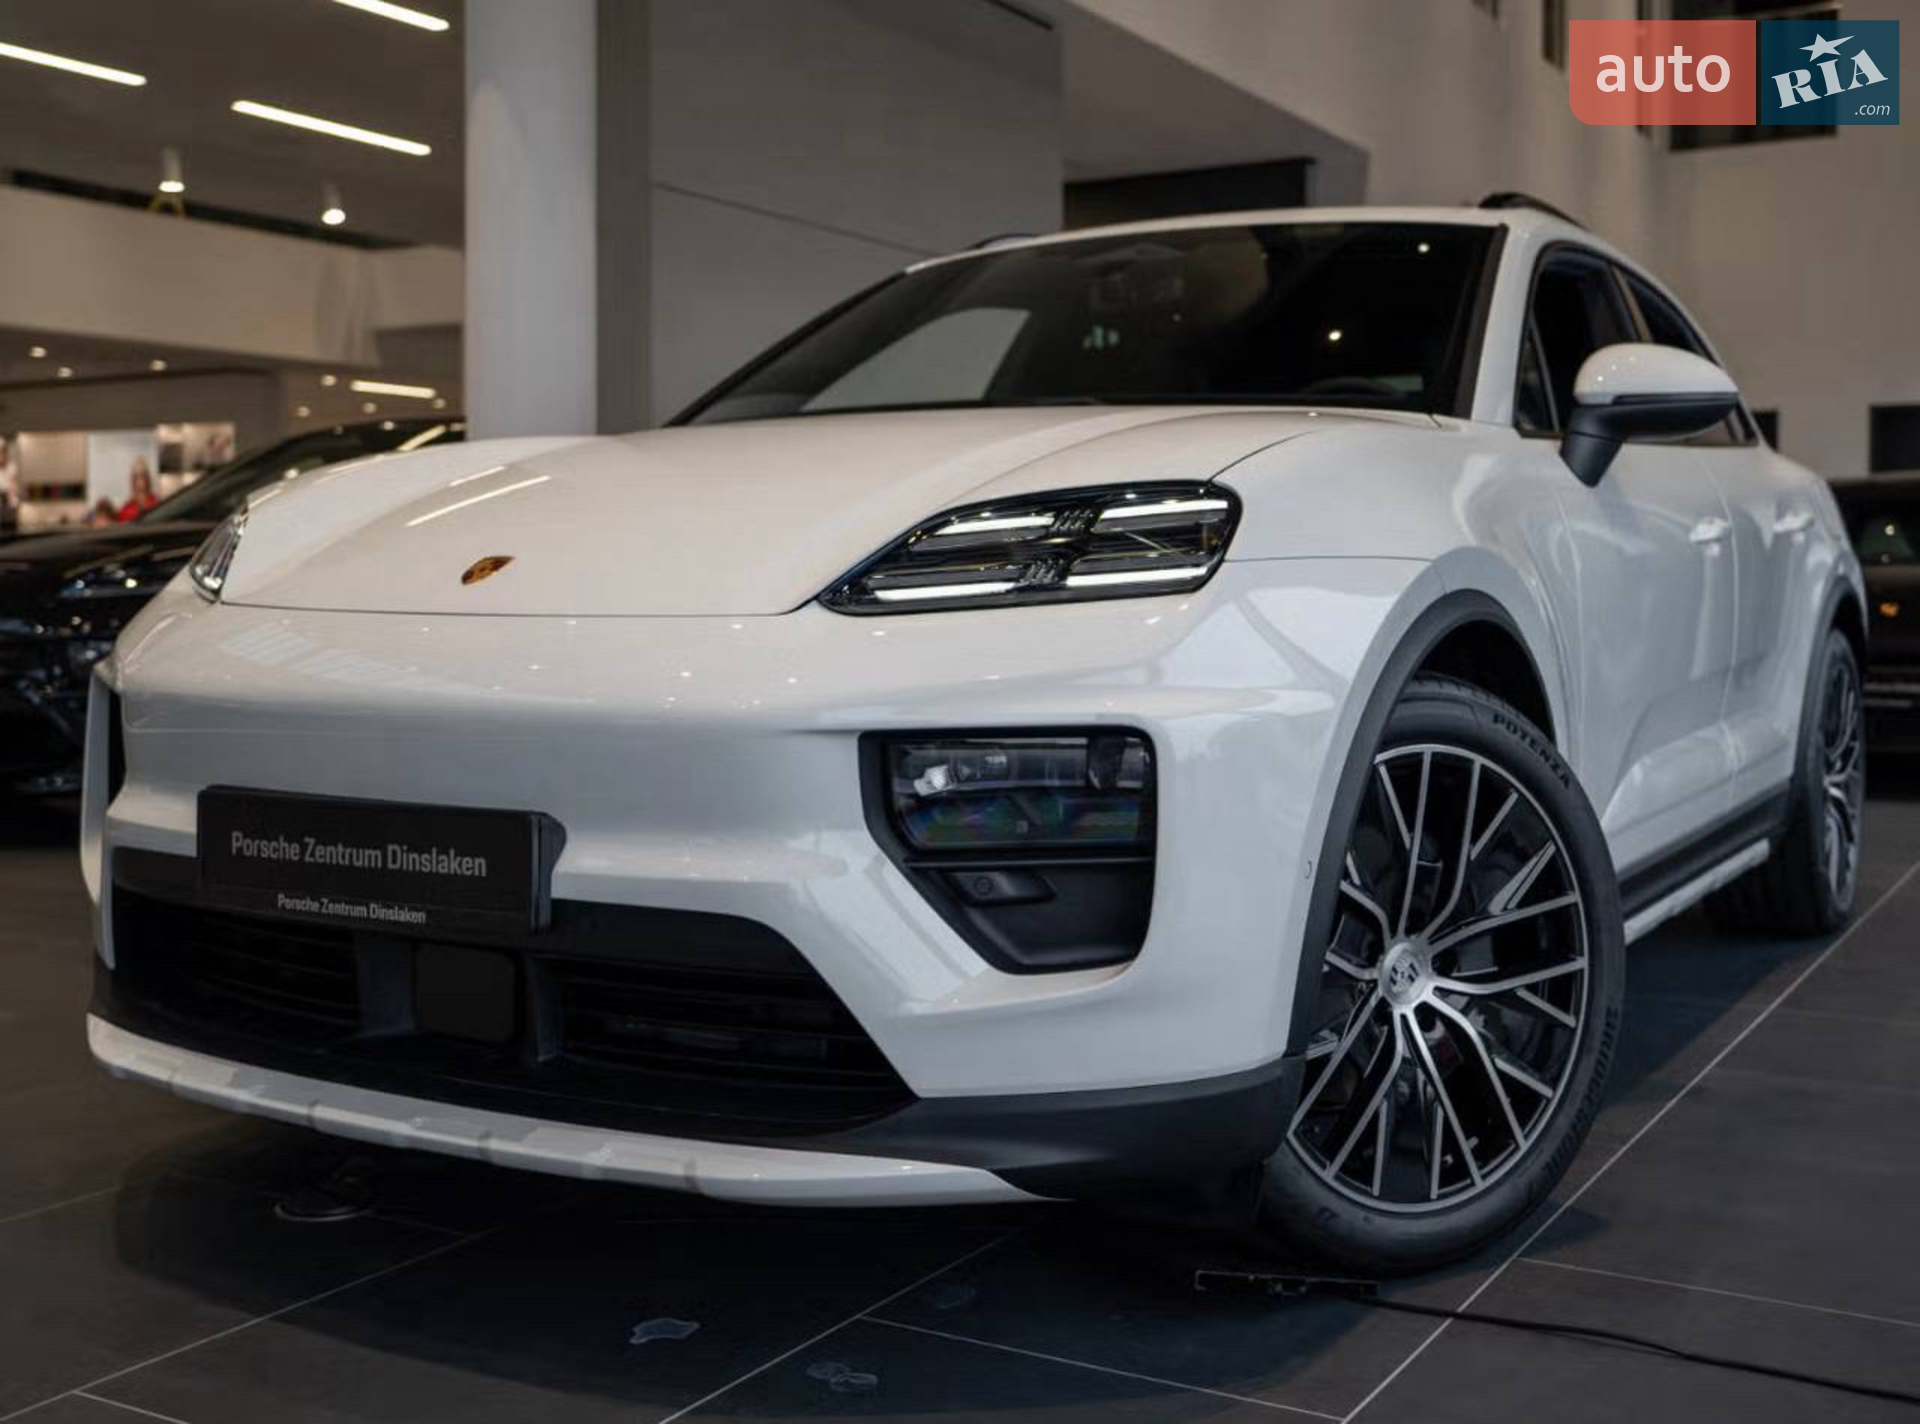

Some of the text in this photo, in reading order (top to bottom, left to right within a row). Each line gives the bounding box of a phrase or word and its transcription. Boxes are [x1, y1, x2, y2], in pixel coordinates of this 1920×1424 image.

[1493, 713, 1570, 789] POTENZA
[231, 831, 487, 877] Porsche Zentrum Dinslaken
[277, 893, 426, 924] Porsche Zentrum Dinslaken
